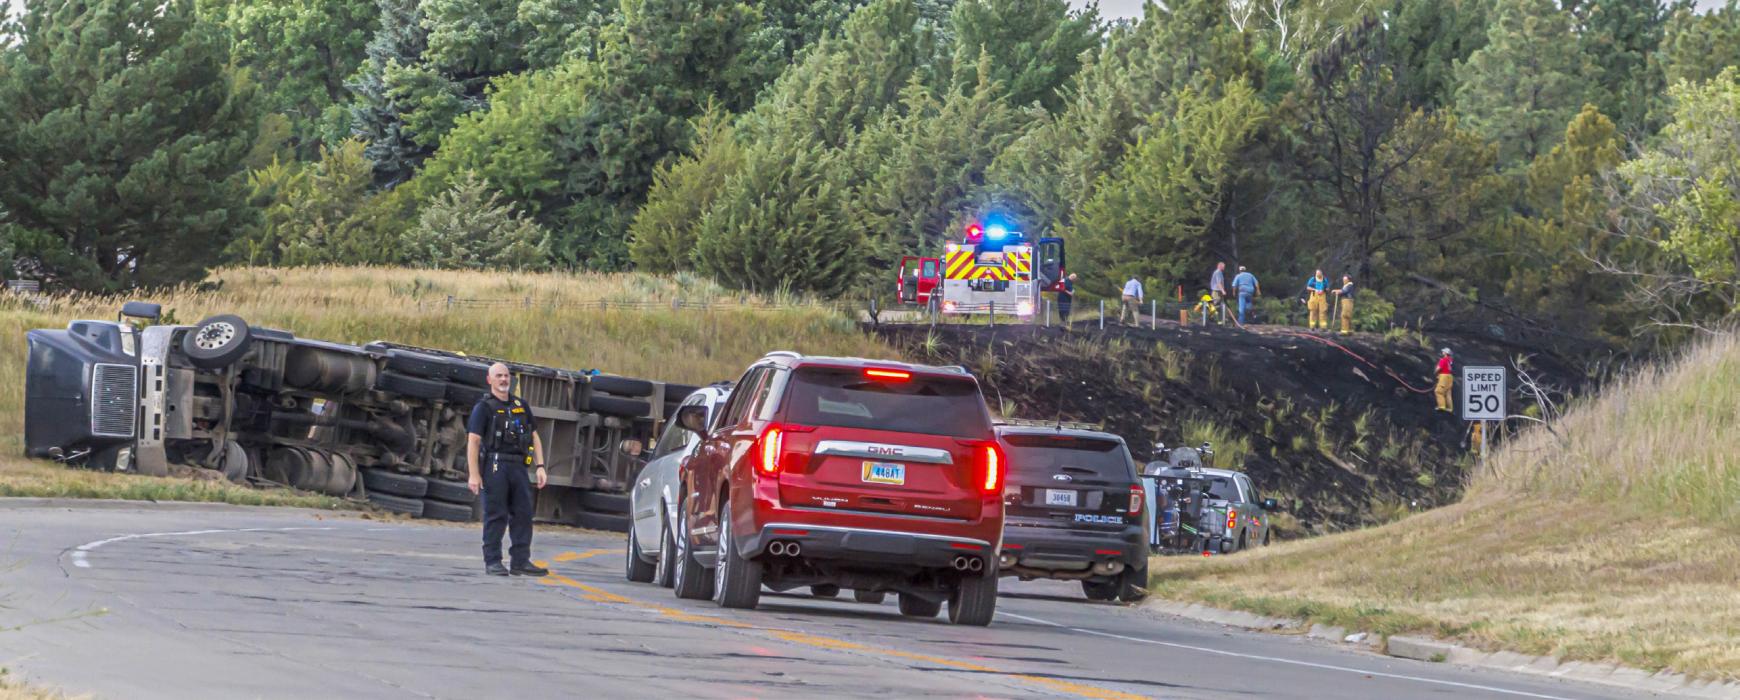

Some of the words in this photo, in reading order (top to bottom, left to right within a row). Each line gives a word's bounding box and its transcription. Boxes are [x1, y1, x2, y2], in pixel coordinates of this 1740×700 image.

[1467, 373, 1502, 382] SPEED
[1470, 383, 1498, 392] LIMIT
[1468, 394, 1500, 413] 50
[867, 446, 904, 456] GMC
[1074, 513, 1123, 524] POLICE
